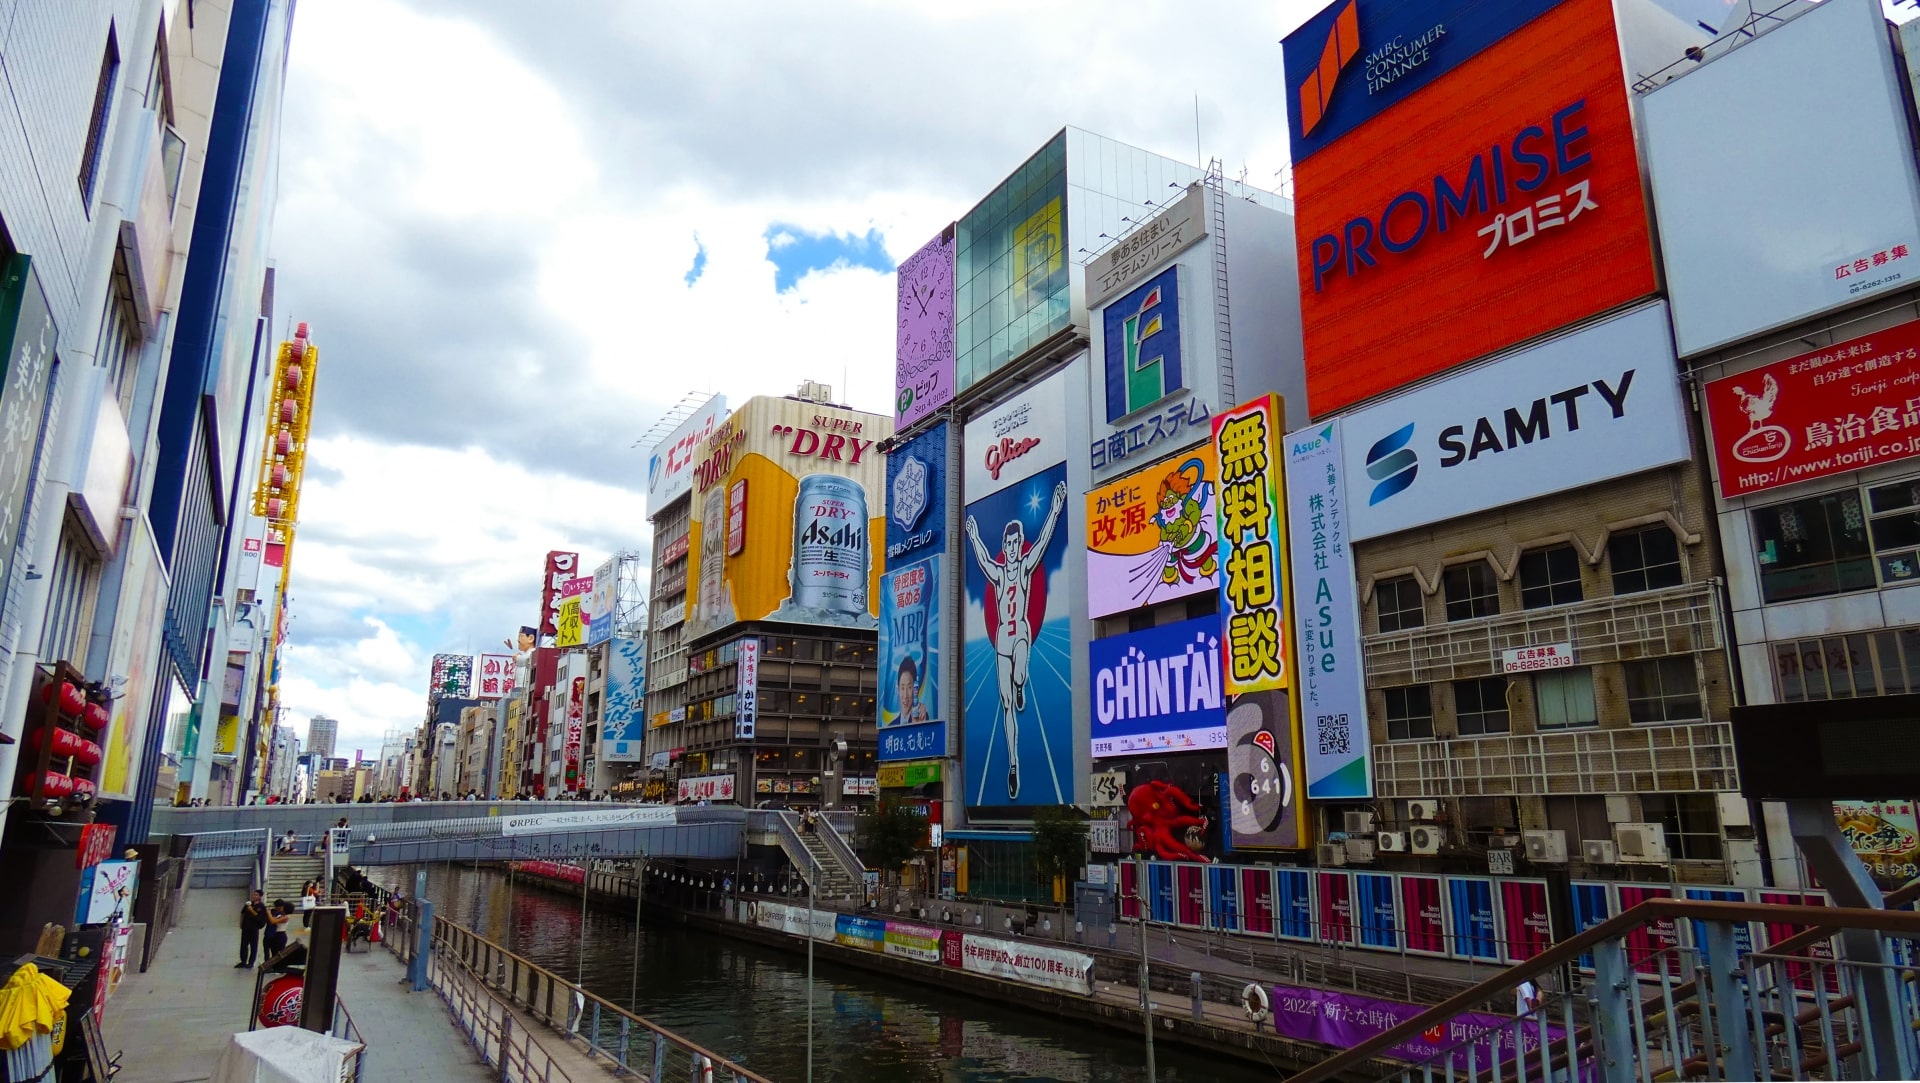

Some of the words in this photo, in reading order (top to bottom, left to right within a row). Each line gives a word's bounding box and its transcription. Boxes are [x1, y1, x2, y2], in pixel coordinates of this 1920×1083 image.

[1365, 34, 1403, 68] SMBC
[1366, 24, 1446, 81] CONSUMER
[1368, 48, 1430, 95] FINANCE
[1311, 98, 1593, 294] PROMISE
[1477, 179, 1599, 260] プロミス
[1103, 229, 1182, 292] エステムシリーズ
[1111, 218, 1170, 265] 夢ある住まい
[1836, 244, 1908, 280] 広告募集
[915, 371, 939, 400] ピップ
[1814, 348, 1916, 386] 自分達で創造する
[1851, 380, 1887, 396] Toriji
[812, 414, 863, 434] SUPER
[1091, 396, 1210, 470] 日商エステム
[1438, 369, 1636, 468] SAMTY
[1805, 399, 1920, 452] 鳥治食品
[985, 438, 1040, 480] Glico
[1292, 438, 1322, 457] Asue
[822, 500, 845, 508] SUPER
[1096, 484, 1142, 515] かぜに
[1326, 462, 1342, 558] 丸善インテックは、
[802, 518, 862, 551] Asahi
[888, 529, 932, 560] 雪印メグミルク
[1092, 502, 1147, 548] 改源
[1309, 494, 1328, 571] 株式会社
[824, 550, 839, 562] 生
[1220, 411, 1279, 680] 無料相談
[893, 566, 926, 594] 骨密度を
[896, 587, 922, 610] 高める
[892, 609, 924, 650] MBP
[1006, 582, 1016, 638] グリコ
[1315, 578, 1336, 674] Asue
[1304, 618, 1319, 708] に変わりました。
[1505, 656, 1571, 672] 06-6262-1313
[1516, 646, 1556, 660] 広告募集
[1097, 776, 1118, 800] くくる
[1488, 852, 1512, 864] BAR
